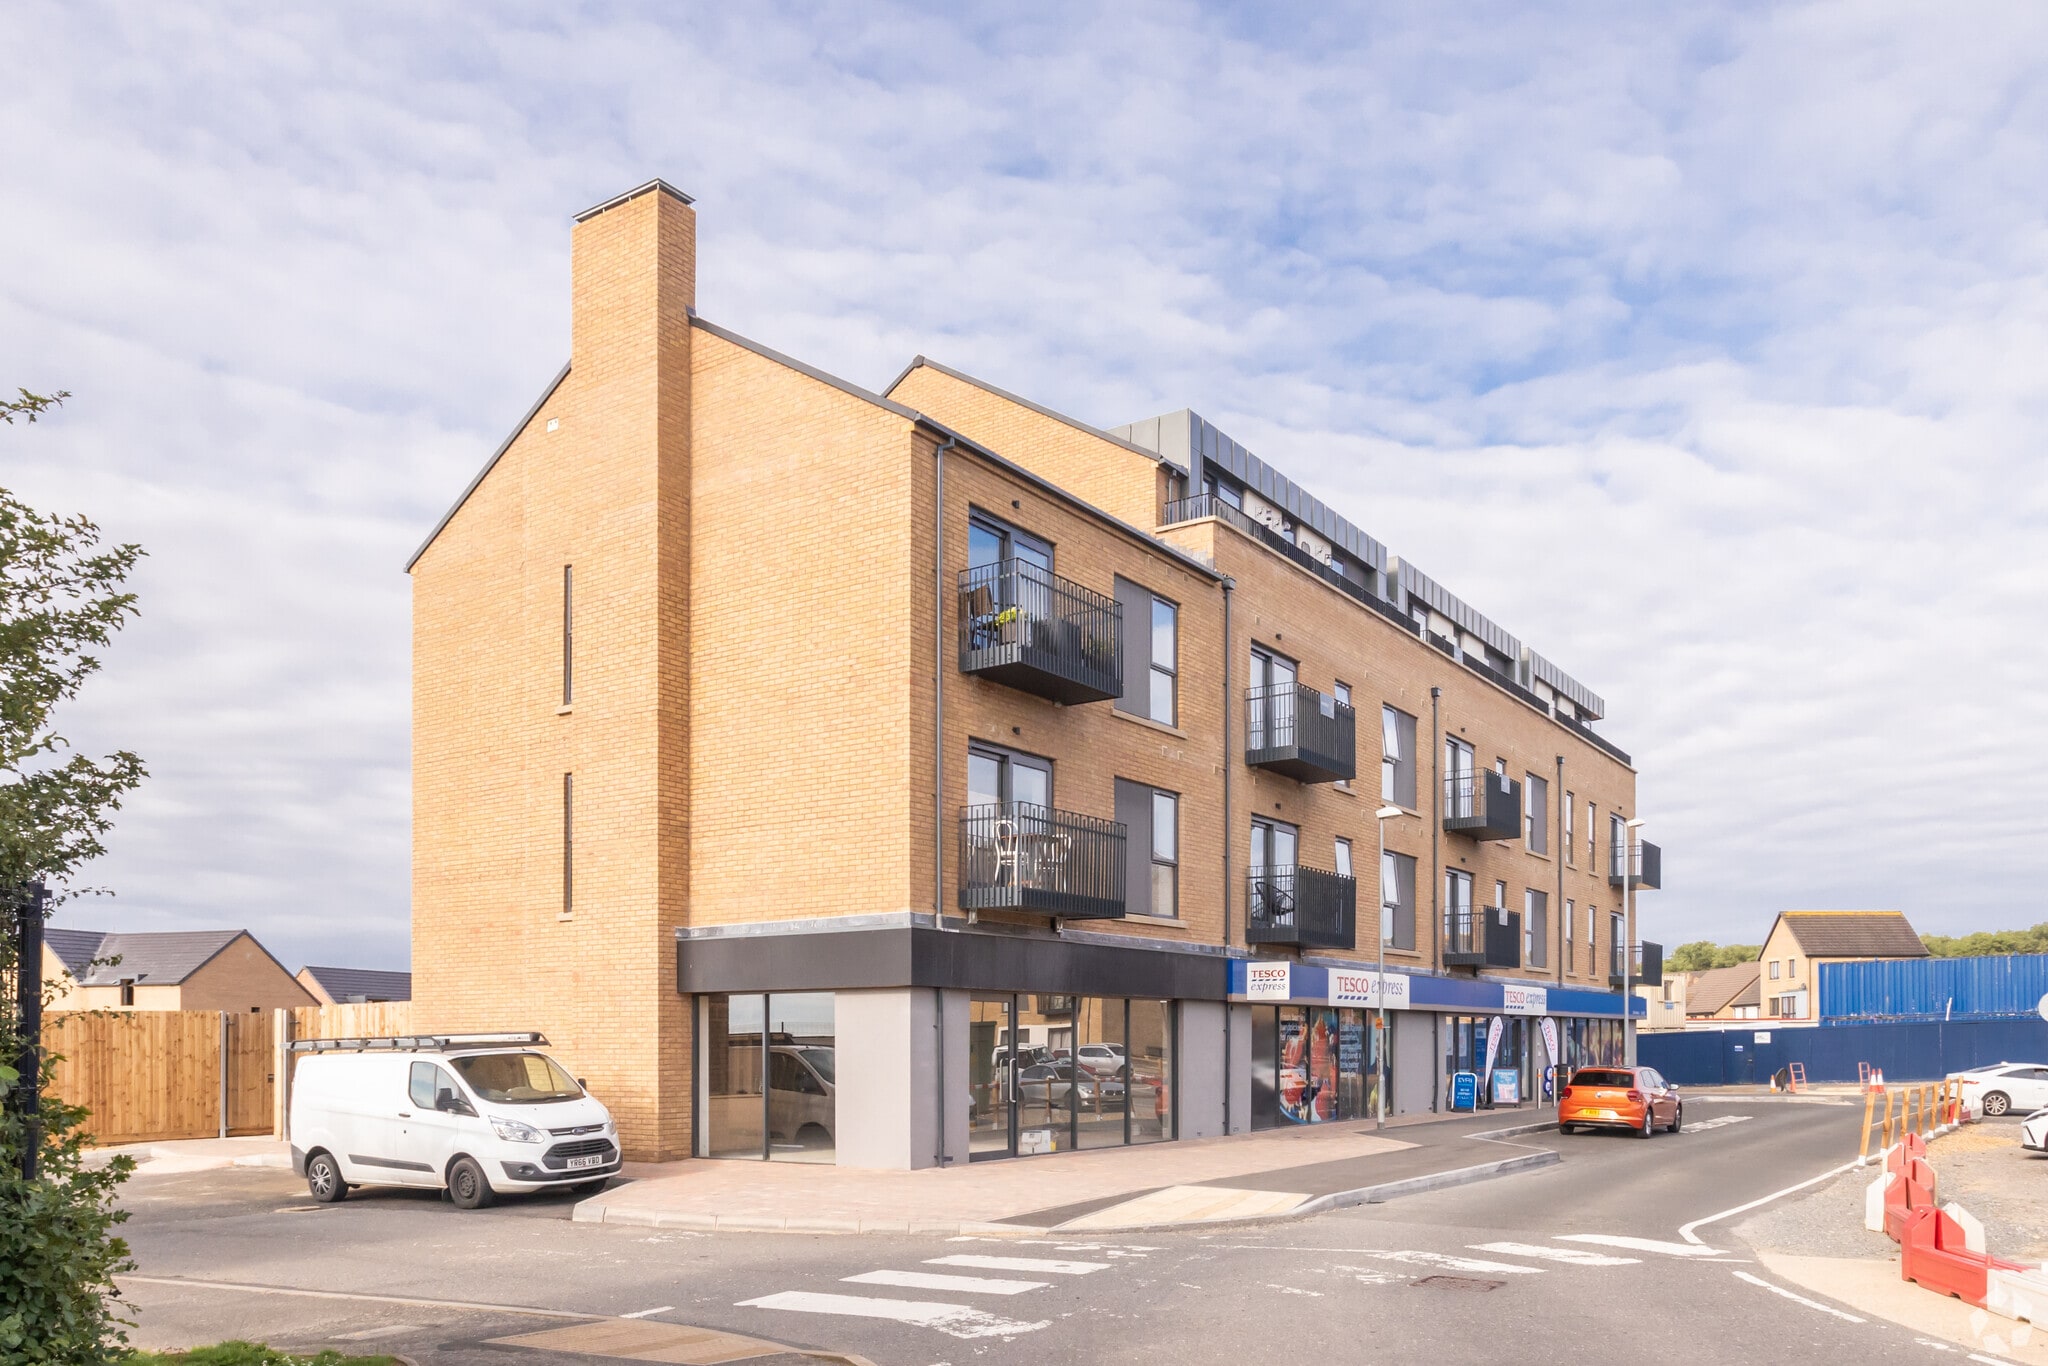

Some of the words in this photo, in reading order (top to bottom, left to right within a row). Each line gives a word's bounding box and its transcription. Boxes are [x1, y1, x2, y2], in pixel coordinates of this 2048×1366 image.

[1251, 969, 1286, 978] TESCO
[1250, 983, 1286, 993] express
[1337, 976, 1369, 993] TESCO
[1505, 990, 1525, 1004] TESCO
[1526, 992, 1546, 1008] express
[1489, 1024, 1502, 1054] TESCO
[1544, 1024, 1556, 1052] TESCO
